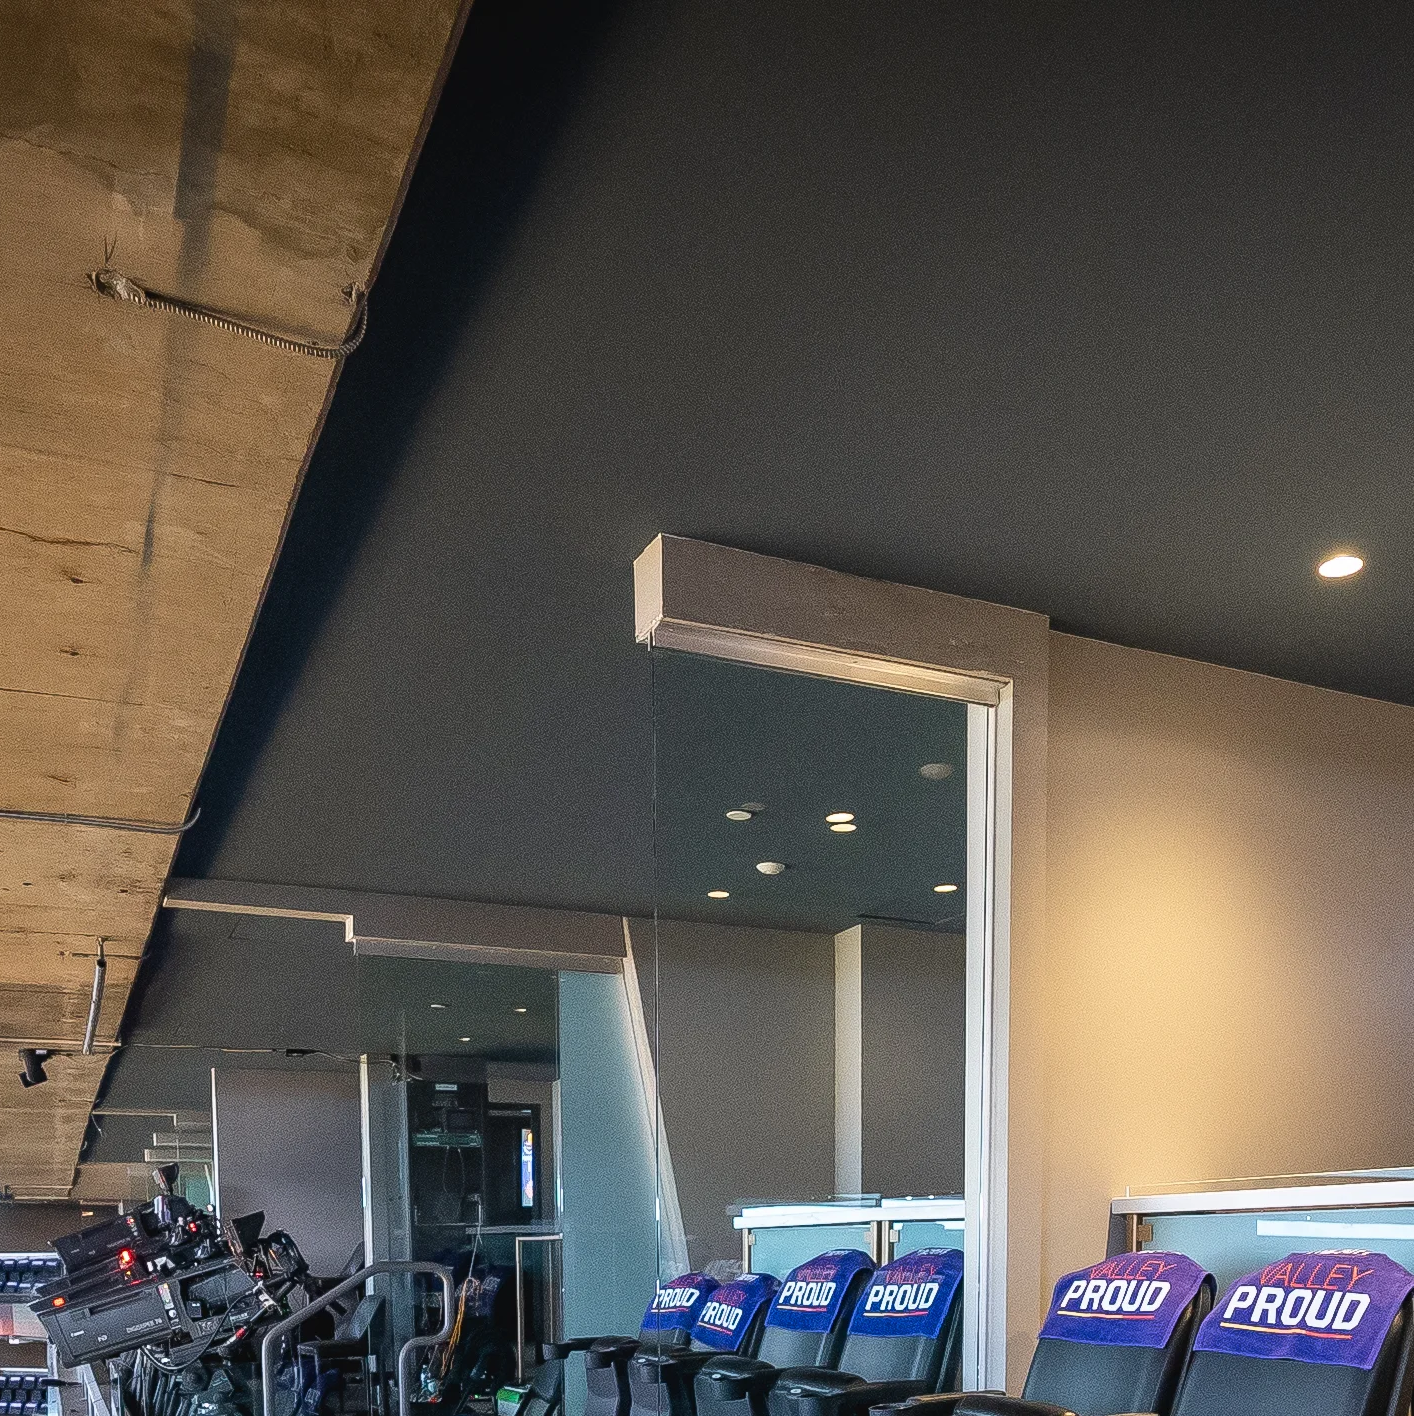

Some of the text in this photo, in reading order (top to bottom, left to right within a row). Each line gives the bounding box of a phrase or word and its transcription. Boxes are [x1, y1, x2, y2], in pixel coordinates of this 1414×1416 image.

[1089, 1259, 1178, 1282] VALLEY
[1260, 1262, 1375, 1291] VALLEY
[654, 1287, 700, 1307] PROUD
[777, 1281, 837, 1307] PROUD
[865, 1282, 939, 1311] PROUD
[1060, 1279, 1171, 1313] PROUD
[1223, 1285, 1371, 1332] PROUD
[699, 1301, 743, 1331] PROUD
